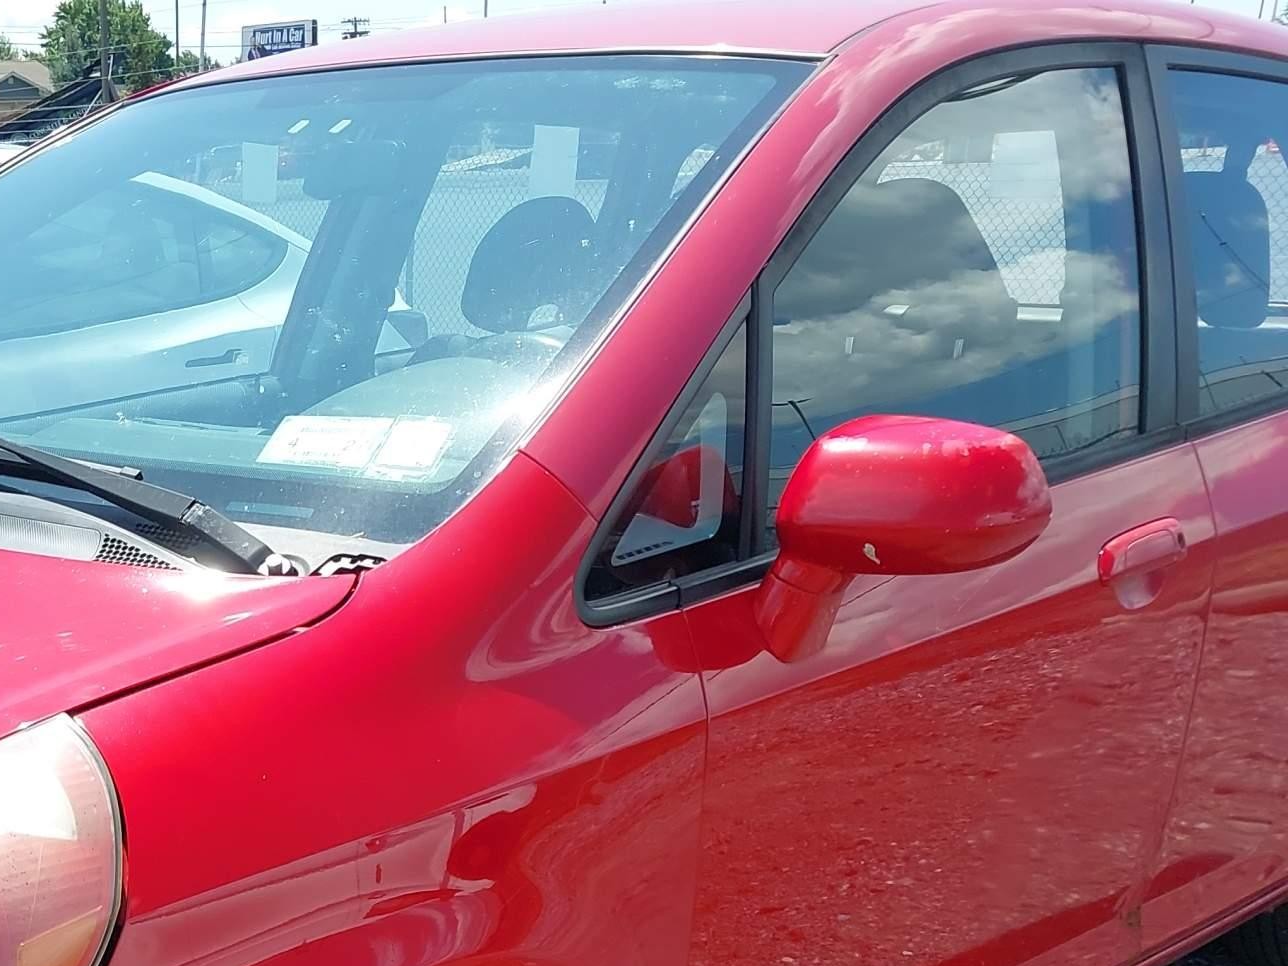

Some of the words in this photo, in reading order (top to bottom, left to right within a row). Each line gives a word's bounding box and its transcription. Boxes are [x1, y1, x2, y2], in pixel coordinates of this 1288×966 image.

[255, 31, 272, 45] Hurt
[273, 29, 281, 43] In
[282, 28, 287, 42] A
[289, 28, 303, 42] Car
